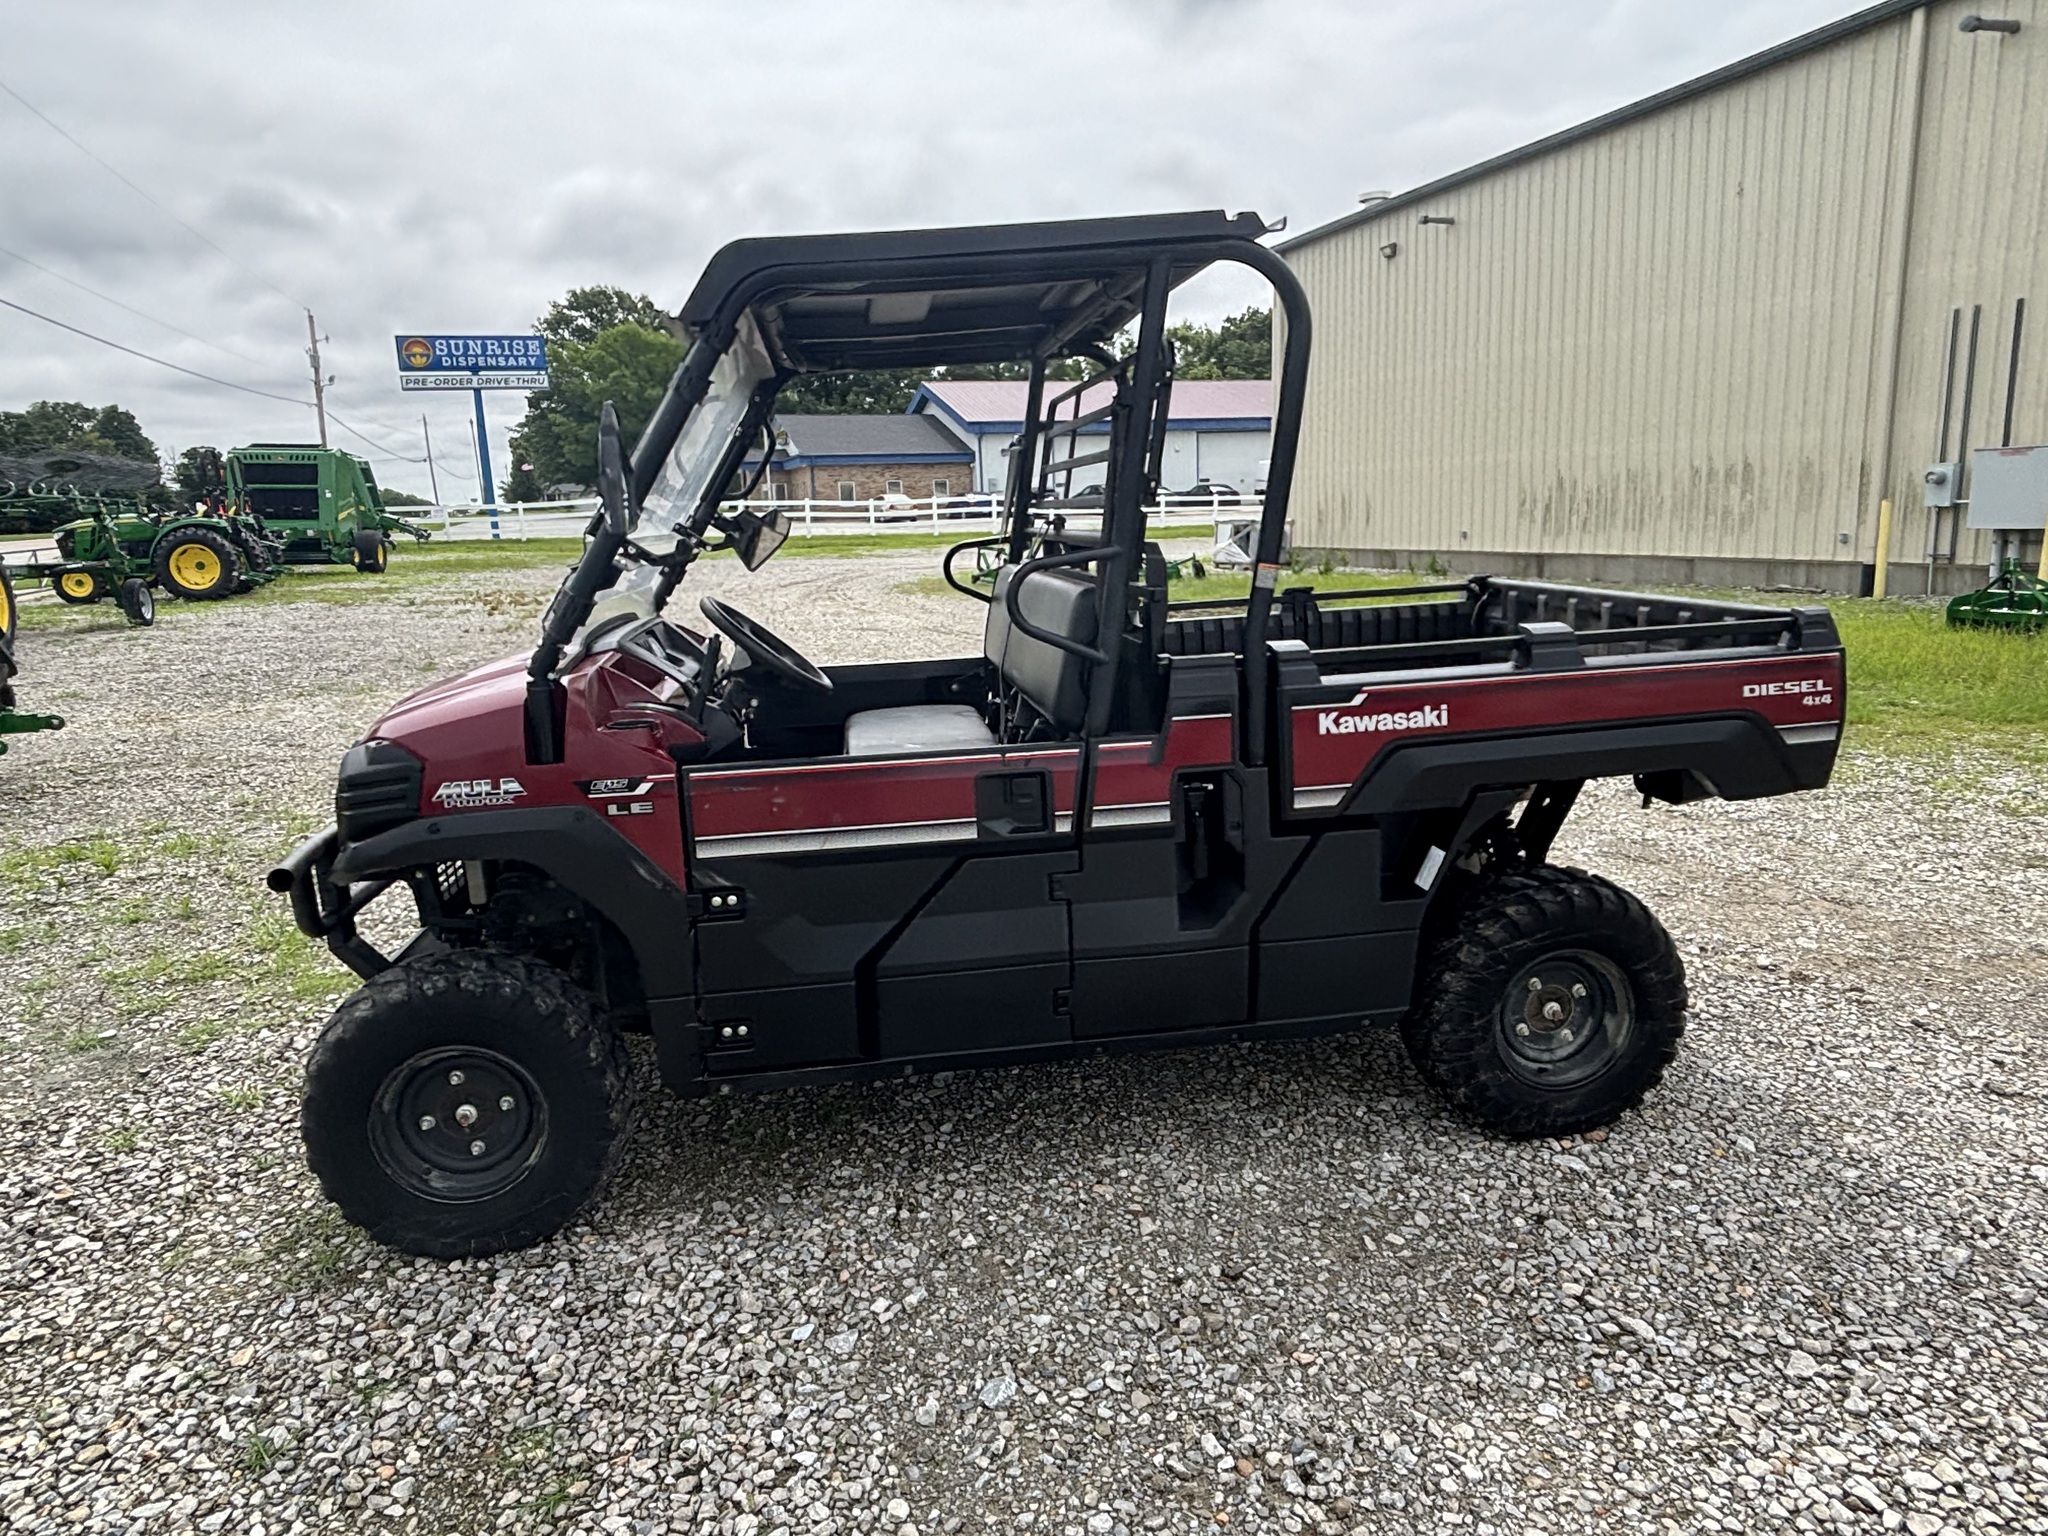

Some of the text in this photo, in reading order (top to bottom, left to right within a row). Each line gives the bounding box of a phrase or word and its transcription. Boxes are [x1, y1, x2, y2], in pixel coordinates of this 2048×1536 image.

[434, 339, 541, 356] SUNRISE
[441, 356, 537, 367] DISPENSARY
[405, 376, 546, 387] PRE-ORDER DRIVE-THRU
[1742, 679, 1833, 698] DIESEL
[1802, 693, 1833, 706] 4x4
[1318, 704, 1449, 735] Kawasaki
[432, 777, 528, 802] MULE
[606, 801, 655, 816] LE
